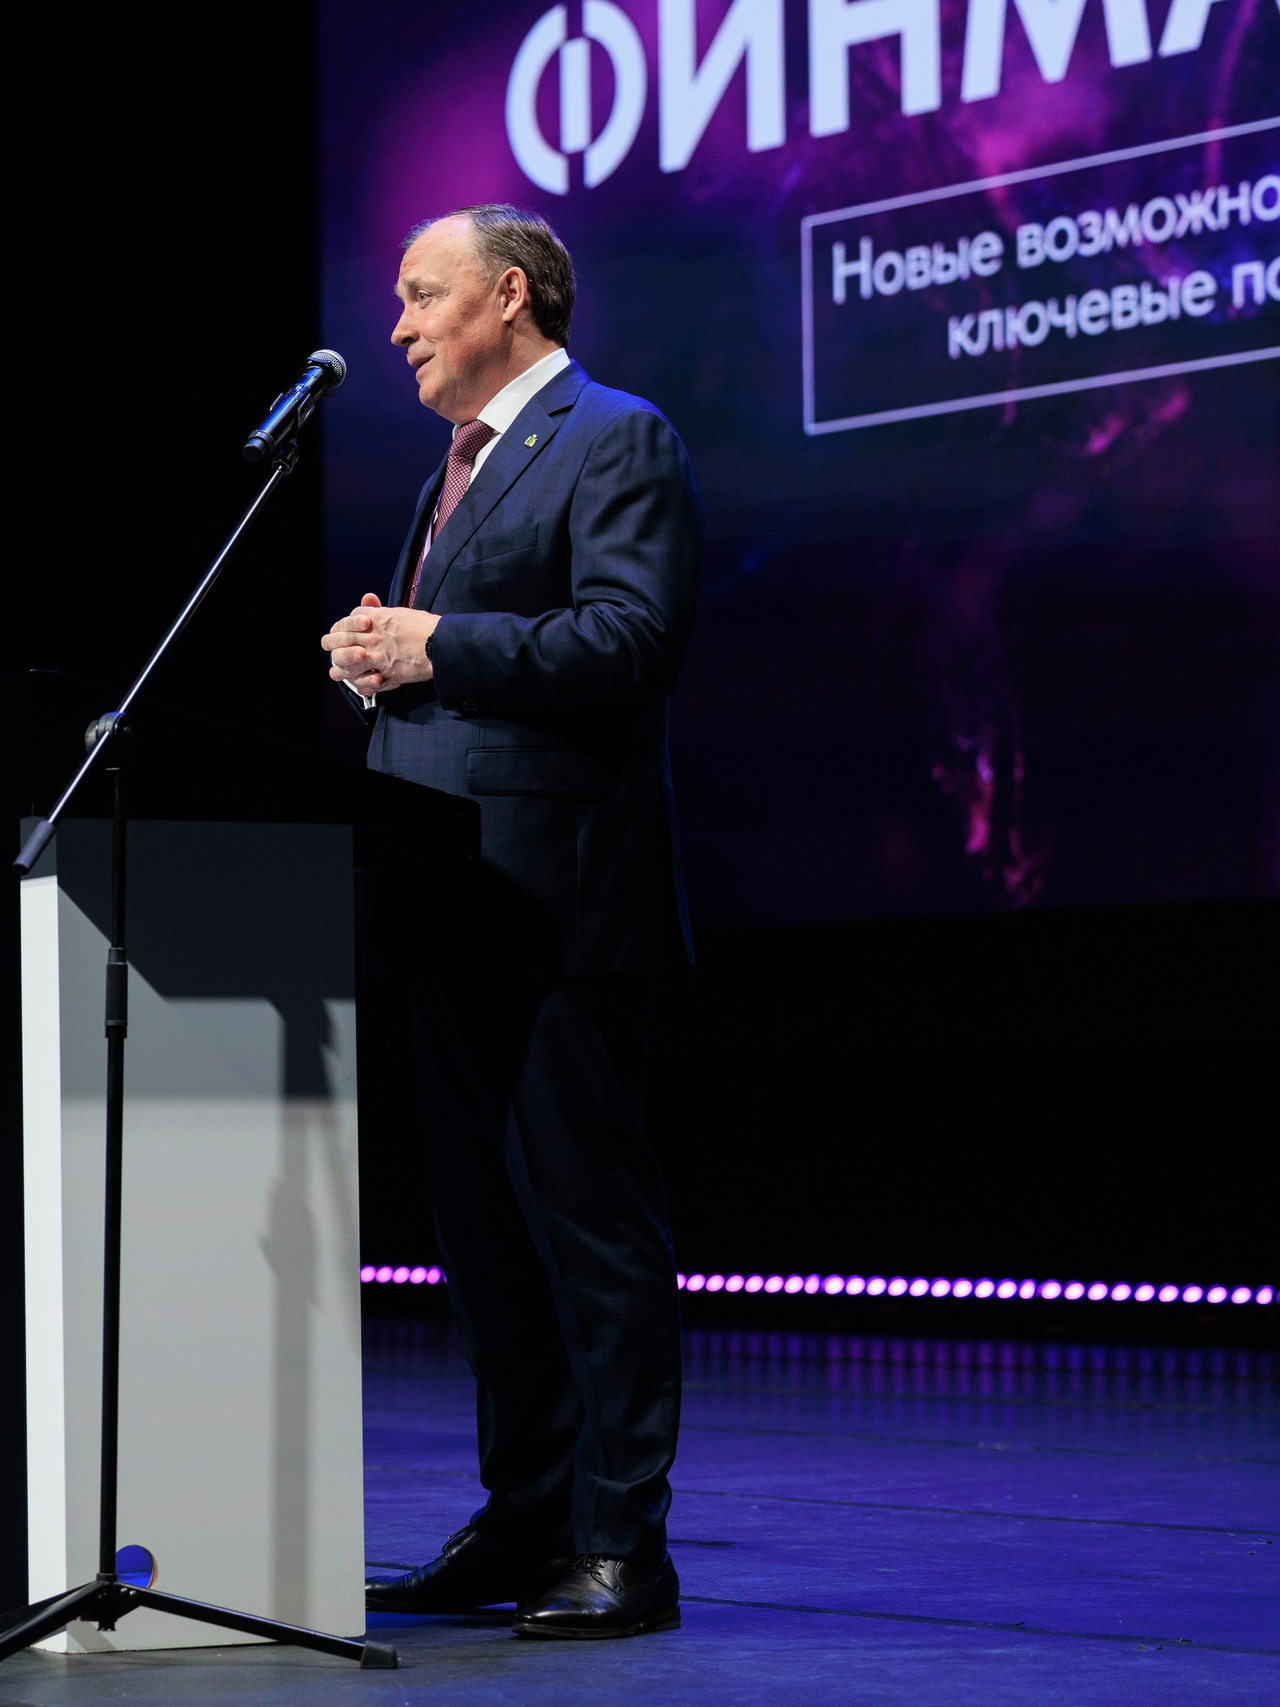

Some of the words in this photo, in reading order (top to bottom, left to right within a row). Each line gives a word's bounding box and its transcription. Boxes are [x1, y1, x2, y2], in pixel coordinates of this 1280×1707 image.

[505, 0, 1280, 196] ФИН
[832, 231, 1004, 305] Новые
[1016, 174, 1280, 269] возможно
[948, 270, 1218, 359] ключевые
